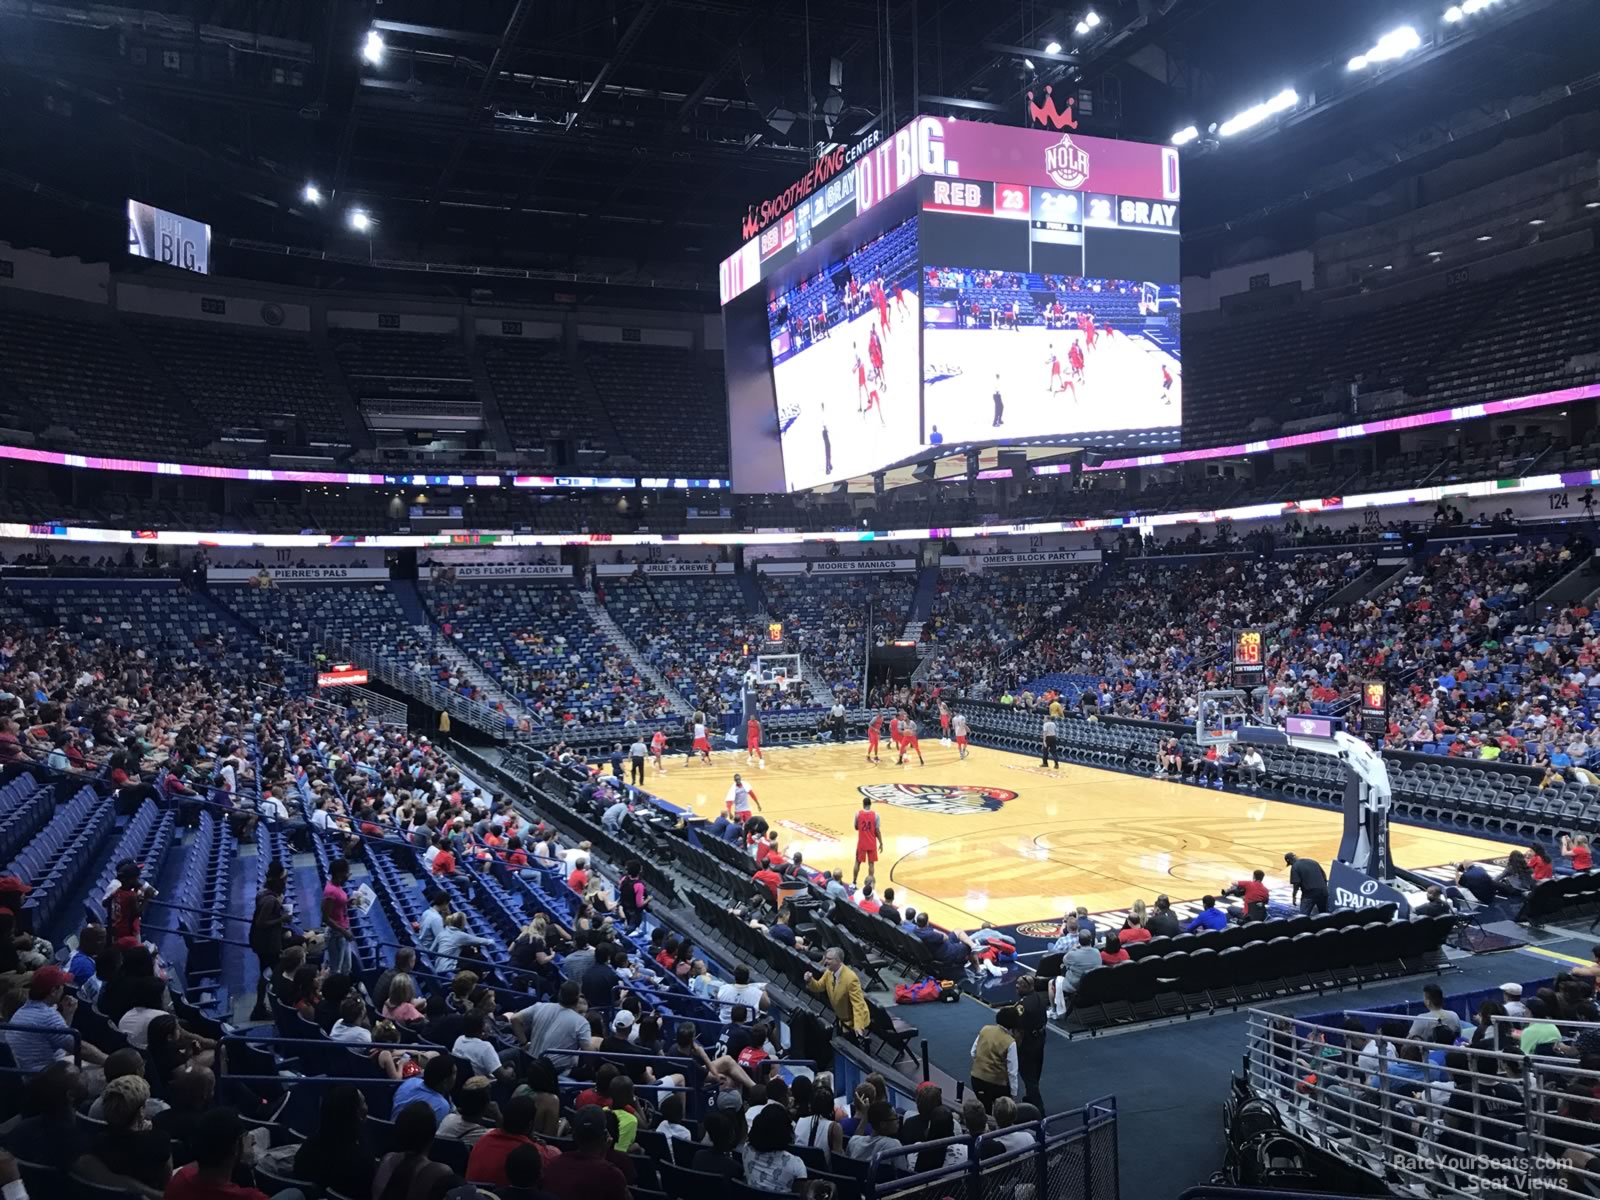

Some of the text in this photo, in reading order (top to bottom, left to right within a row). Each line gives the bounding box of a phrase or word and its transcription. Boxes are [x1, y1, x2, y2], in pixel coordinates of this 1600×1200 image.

[1046, 147, 1089, 178] NOLA
[876, 140, 892, 201] IT
[760, 170, 813, 228] SMOOTHIE
[846, 130, 879, 164] CENTER
[934, 180, 982, 207] RED
[162, 233, 202, 272] BIG.
[1548, 493, 1569, 510] 124
[1364, 511, 1381, 525] 123
[1030, 536, 1043, 547] 121
[276, 549, 291, 561] 117
[983, 552, 1077, 563] OMER'S BLOCK PARTY
[484, 567, 518, 575] FLIGHT
[520, 566, 565, 574] ACADEMY
[817, 561, 896, 570] MOORE'S MANIACS
[275, 569, 348, 578] PIERRE'S PALS
[1244, 644, 1258, 663] 19
[861, 820, 872, 832] 24
